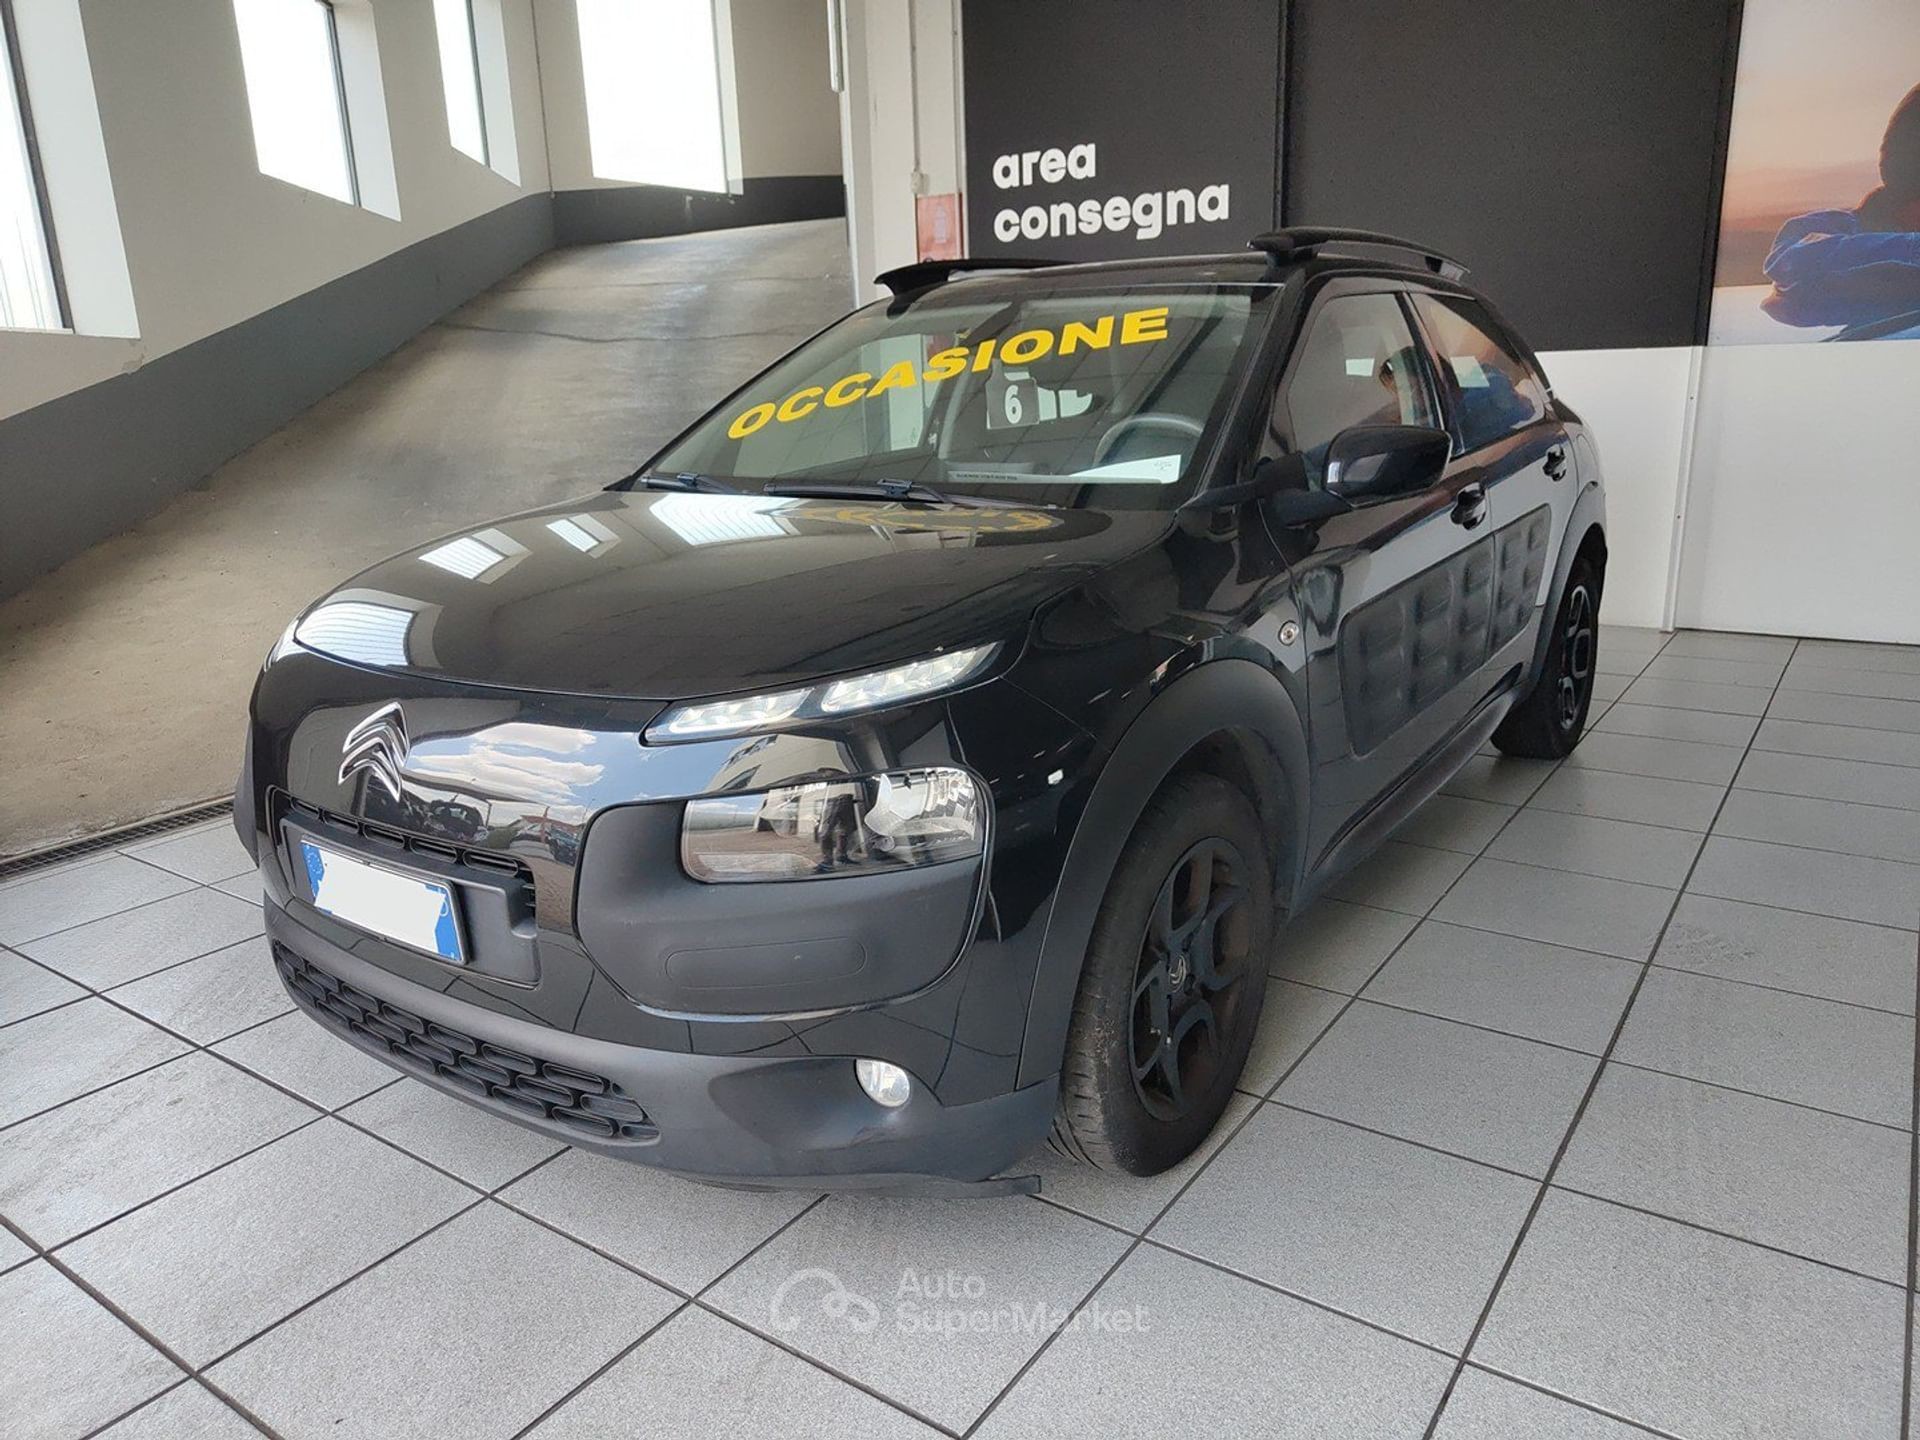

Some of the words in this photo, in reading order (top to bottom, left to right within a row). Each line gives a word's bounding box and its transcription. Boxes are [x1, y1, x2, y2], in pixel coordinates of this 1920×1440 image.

[992, 143, 1096, 189] area
[993, 183, 1230, 242] consegna
[727, 306, 1170, 440] OCCASIONE
[1004, 384, 1023, 425] 6
